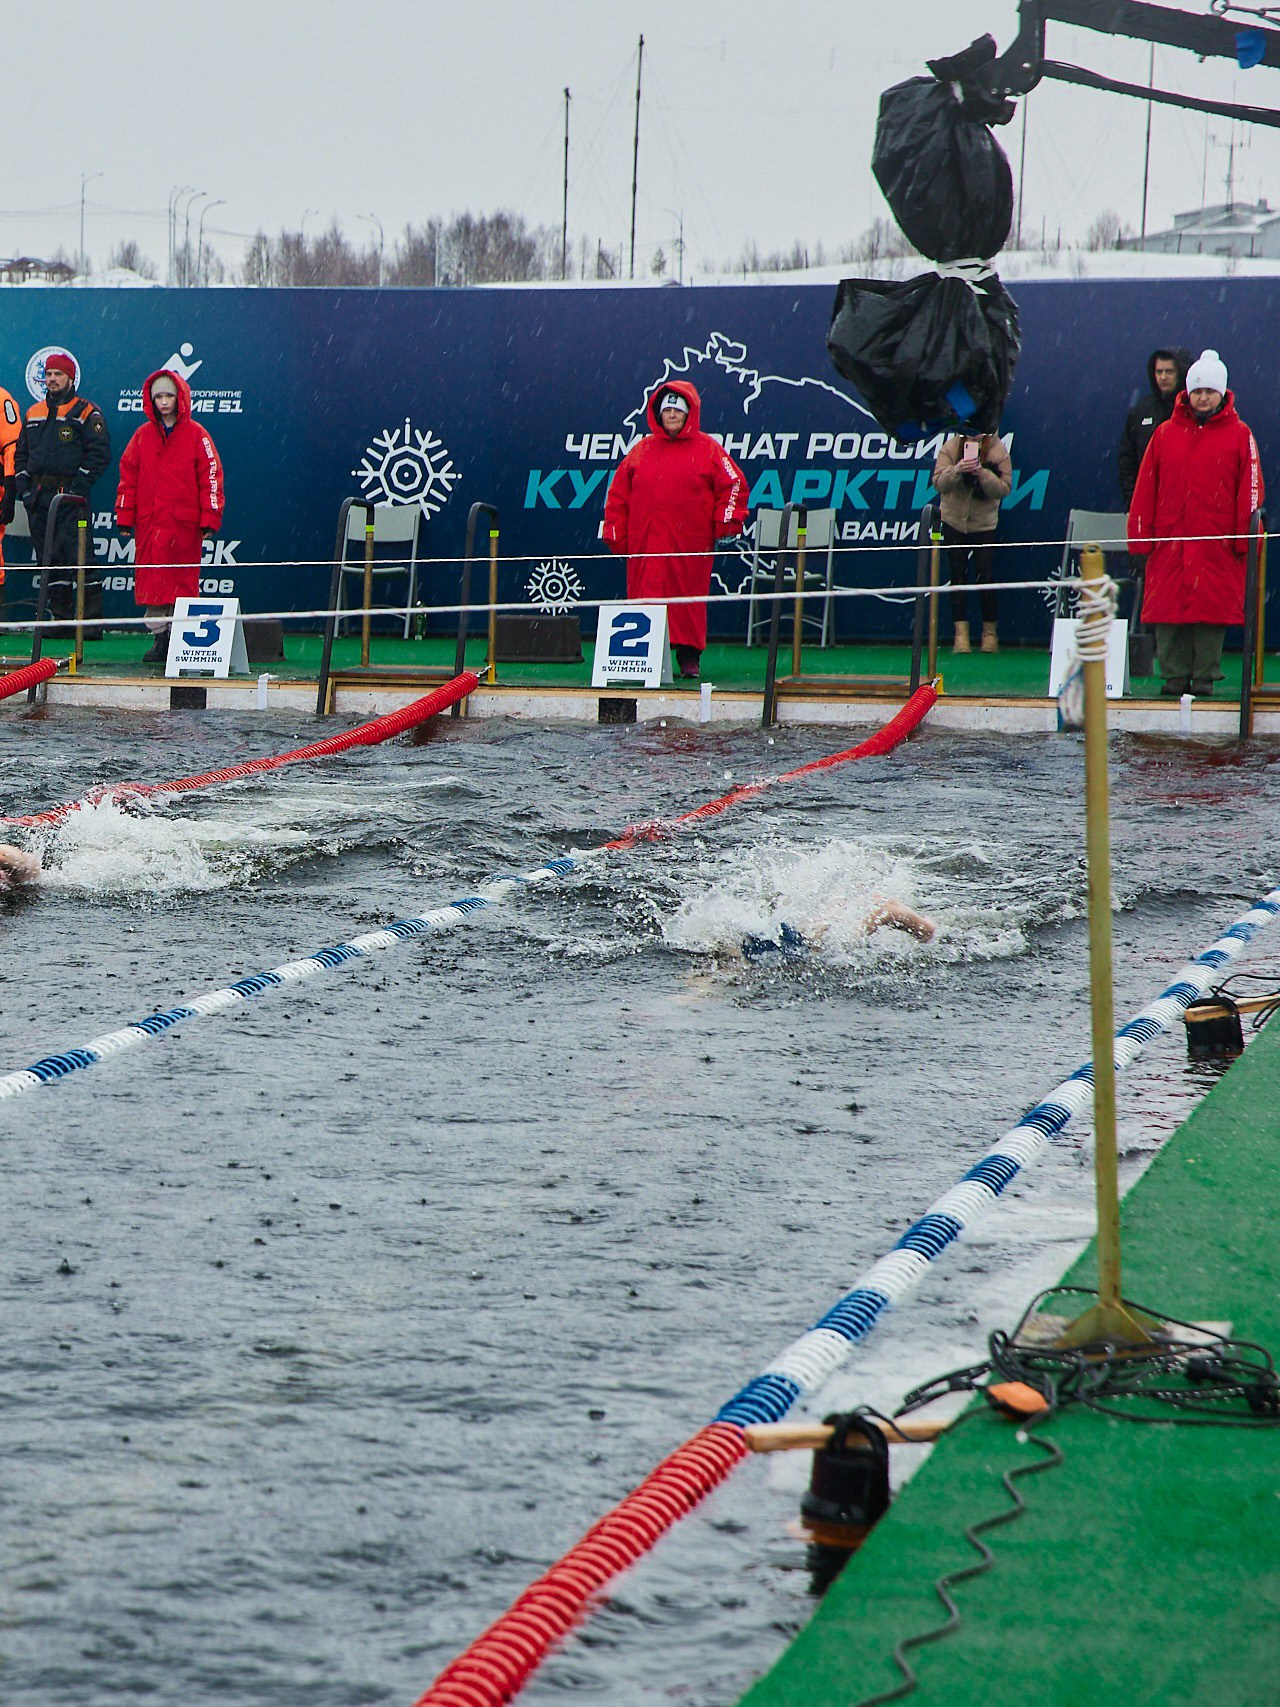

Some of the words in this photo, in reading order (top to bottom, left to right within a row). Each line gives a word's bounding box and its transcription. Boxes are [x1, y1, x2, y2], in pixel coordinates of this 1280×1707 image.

[190, 390, 242, 398] ЕРОПРИЯТИЕ
[218, 400, 243, 413] 51
[565, 433, 799, 460] ЧЕМНАТ
[806, 432, 956, 460] РОССИ
[748, 469, 1050, 510] АРКТИИ
[182, 604, 225, 648] 3
[608, 612, 652, 657] 2
[609, 659, 647, 667] WINTER
